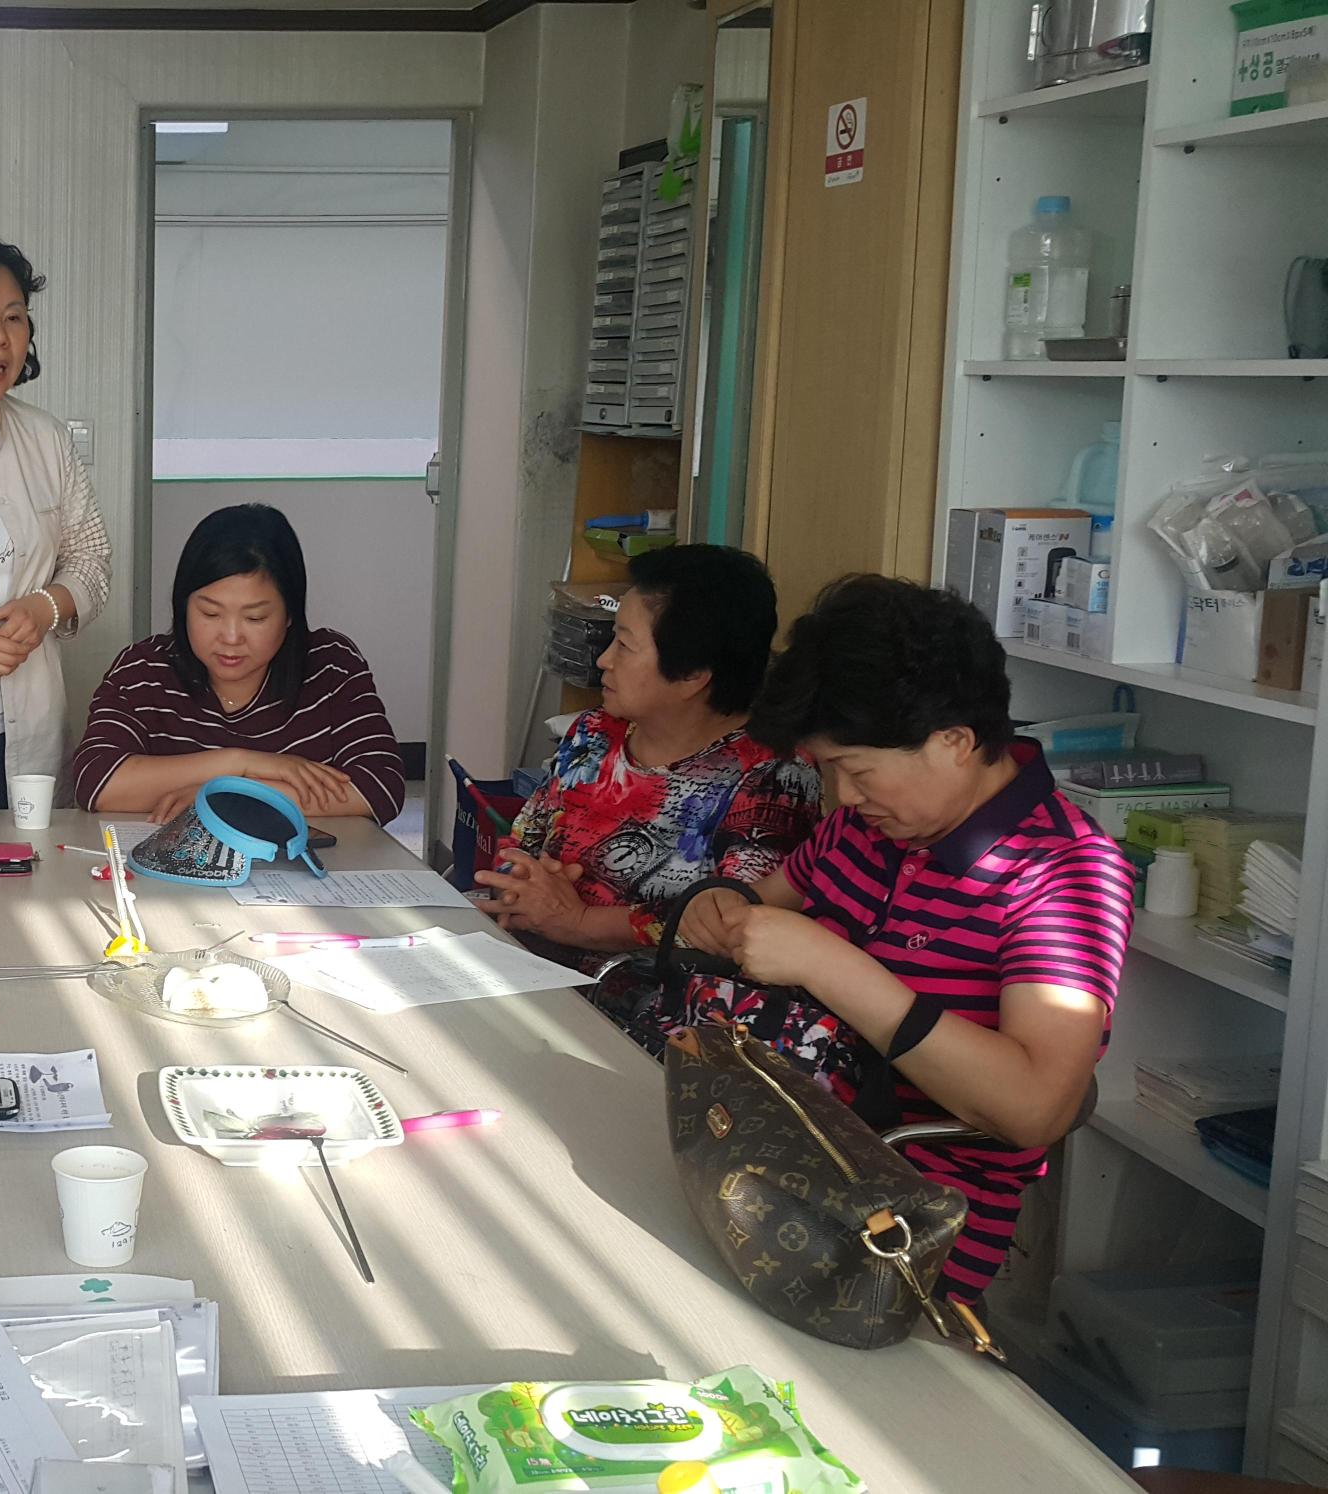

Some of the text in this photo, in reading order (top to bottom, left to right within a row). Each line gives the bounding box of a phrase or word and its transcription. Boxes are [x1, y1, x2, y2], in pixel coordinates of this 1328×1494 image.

[1116, 800, 1200, 814] FACE MASK
[569, 1406, 689, 1426] 네이처그린
